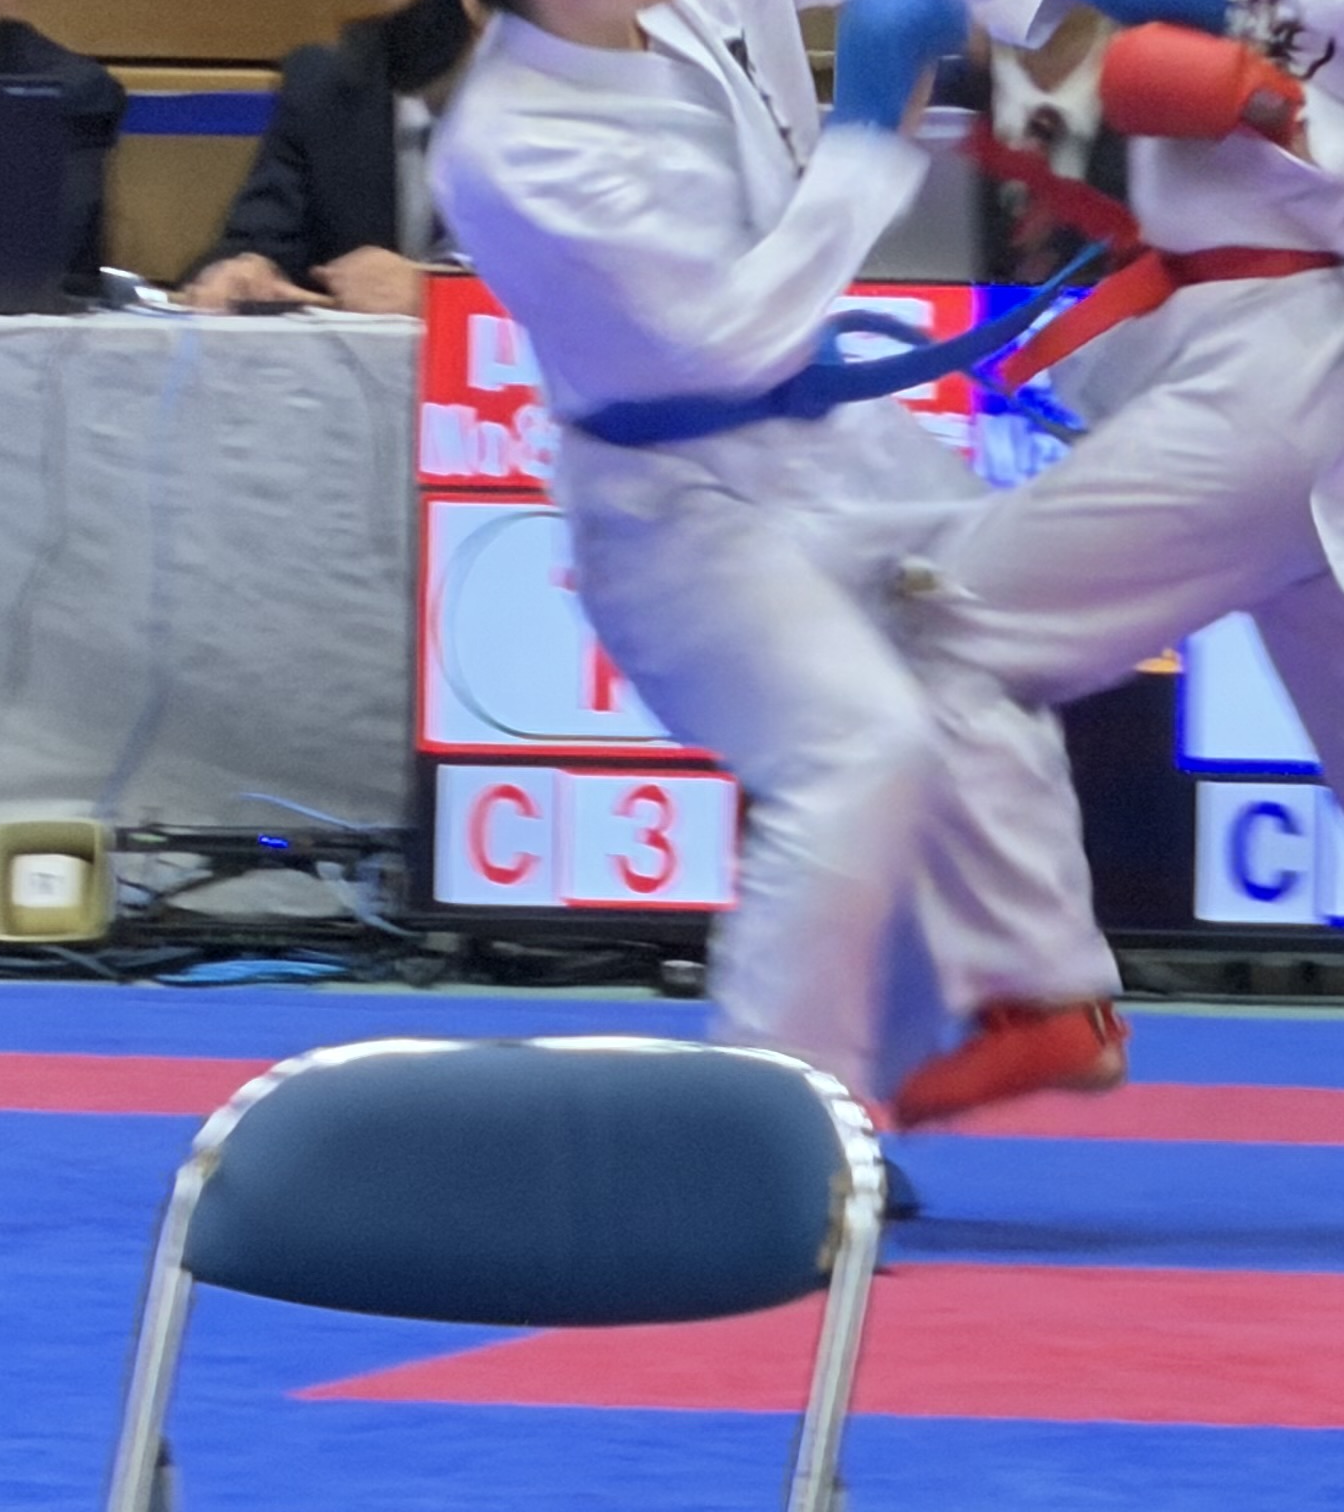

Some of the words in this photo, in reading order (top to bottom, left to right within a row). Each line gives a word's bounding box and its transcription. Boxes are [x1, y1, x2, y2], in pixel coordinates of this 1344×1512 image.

[467, 784, 541, 886] C
[612, 784, 680, 894] 3
[1226, 800, 1304, 904] C
